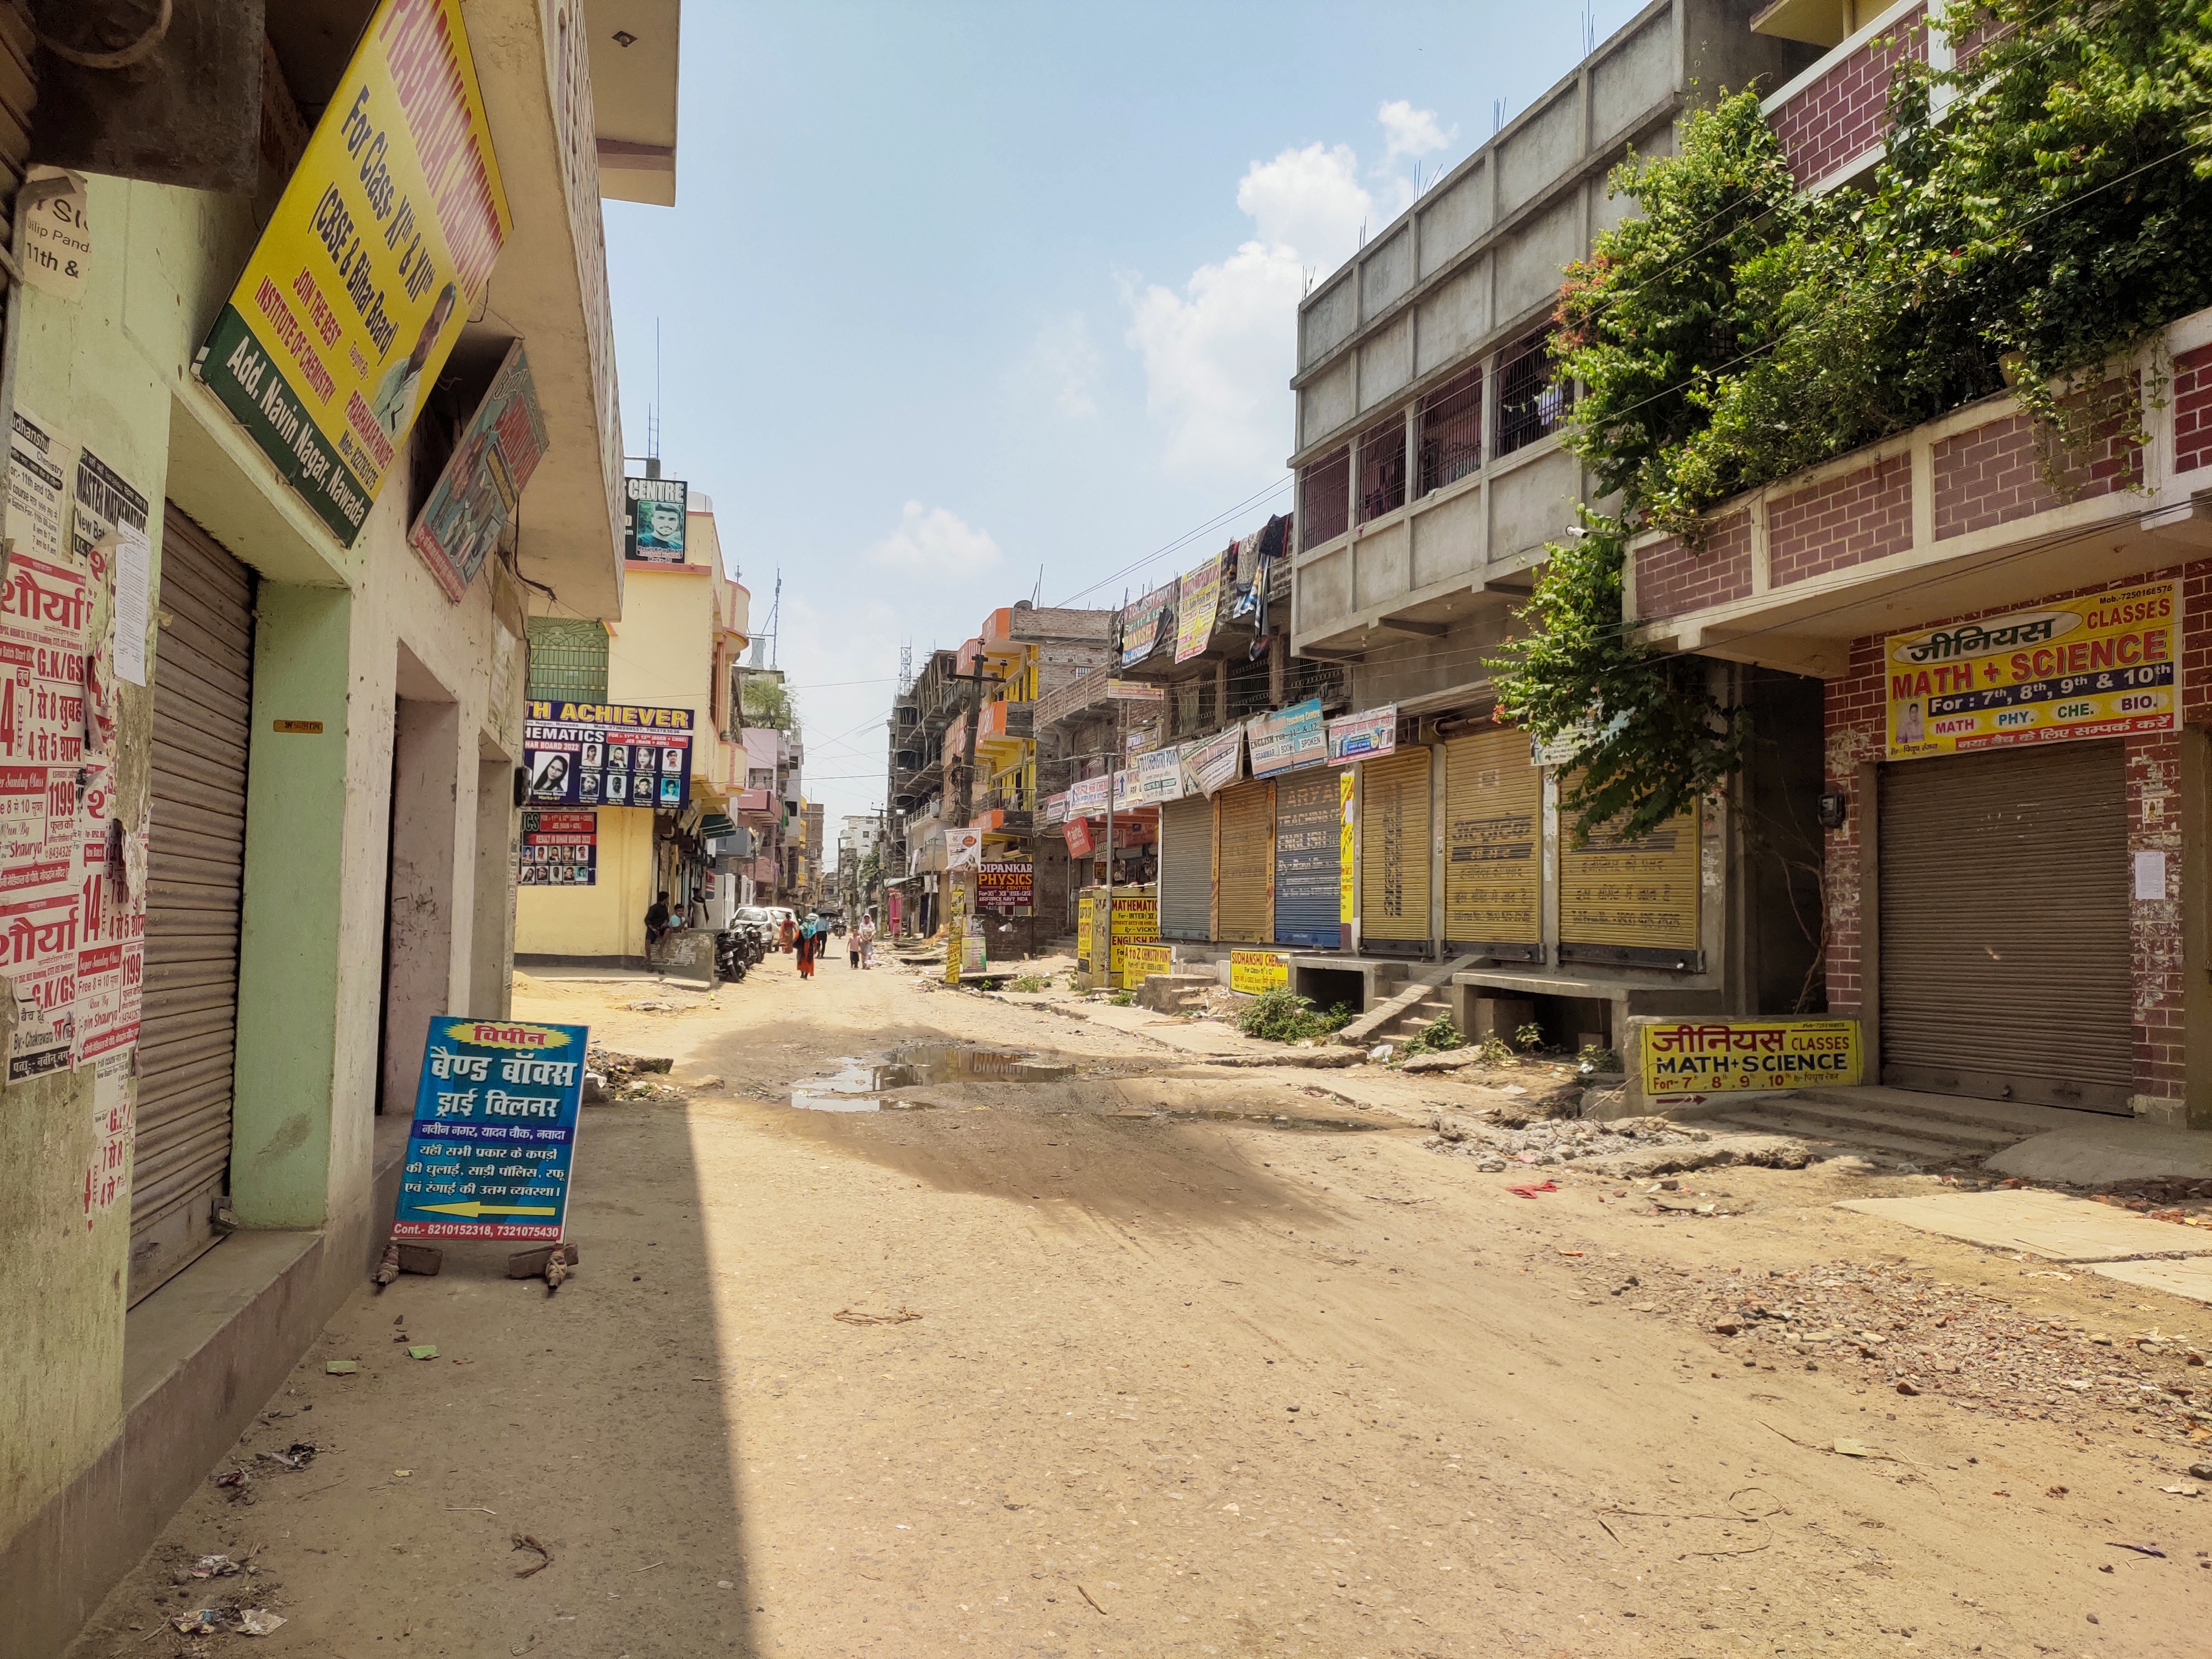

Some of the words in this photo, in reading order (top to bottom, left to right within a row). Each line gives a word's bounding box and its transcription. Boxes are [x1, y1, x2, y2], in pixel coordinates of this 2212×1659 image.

[341, 84, 373, 162] For
[399, 232, 421, 278] &
[307, 181, 355, 265] (CBSE
[436, 133, 504, 305] CHEMISTRY
[27, 242, 59, 271] 11th
[65, 260, 79, 279] &
[338, 236, 361, 279] &
[346, 249, 376, 317] Bihar
[254, 274, 299, 349] INSTITUTE
[293, 265, 317, 308] JOIN
[308, 289, 329, 328] THE
[319, 312, 342, 352] BEST
[289, 330, 308, 360] OF
[364, 289, 400, 367] Board)
[348, 340, 364, 368] Taught
[298, 344, 337, 407] CHEMISTRY
[226, 335, 268, 400] Add.
[259, 376, 300, 445] Navin
[293, 421, 333, 493] Nagar,
[326, 465, 366, 528] Nawada
[344, 388, 382, 455] PRABHAKAR
[373, 431, 395, 473] PANDEY
[34, 482, 44, 495] and
[76, 463, 105, 518] MASTER
[628, 479, 685, 503] CENTRE
[75, 507, 92, 535] New
[1906, 618, 2056, 661] जीनियस
[2086, 598, 2171, 630] CLASSES
[37, 648, 84, 684] G.K/GS
[1892, 662, 1973, 701] MATH
[1983, 661, 2001, 683] +
[2010, 629, 2168, 682] SCIENCE
[1931, 698, 1964, 713] For
[2060, 676, 2088, 695] 9th
[2096, 673, 2115, 690] &
[2124, 665, 2171, 686] 10th
[29, 688, 34, 718] 7
[36, 684, 48, 719] से
[50, 691, 56, 722] 8
[59, 695, 83, 731] सुबह
[560, 703, 689, 728] ACHIEVER
[1936, 718, 1975, 735] MATH
[1999, 711, 2034, 727] PHY.
[2058, 703, 2095, 718] CHE.
[2122, 695, 2157, 711] BIO.
[28, 731, 35, 761] 4
[38, 727, 49, 761] से
[50, 733, 56, 761] 5
[60, 736, 82, 762] शाम
[1250, 735, 1274, 750] ENGLISH
[1301, 736, 1321, 748] SPOKEN
[1958, 738, 1988, 748] नया
[2018, 730, 2037, 742] के
[2040, 728, 2071, 740] लिए
[2074, 719, 2132, 737] सम्पर्क
[2136, 714, 2171, 729] करें
[21, 799, 30, 814] 10
[49, 781, 75, 817] 1199
[9, 840, 43, 859] Shaurya
[978, 863, 1033, 873] DIPANKAR
[978, 874, 1033, 885] PHYSICS
[83, 874, 102, 943] 14
[122, 952, 142, 987] 1199
[1232, 952, 1264, 967] SUDHANSHU
[78, 980, 92, 994] Free
[473, 1025, 547, 1046] विपीन
[1652, 1024, 1787, 1053] जीनियस
[1791, 1037, 1850, 1051] CLASSES
[430, 1046, 493, 1082] बैण्ड
[501, 1052, 578, 1087] बॉक्स
[435, 1088, 478, 1118] ड्राई
[485, 1089, 560, 1118] क्लिनर
[422, 1124, 450, 1136] नवीन
[451, 1125, 478, 1138] नगर,
[481, 1127, 507, 1138] यादव
[509, 1126, 534, 1141] चौक,
[536, 1128, 565, 1140] नवादा
[419, 1142, 444, 1156] यहाँ
[446, 1145, 472, 1157] सभी
[475, 1147, 507, 1159] प्रकार
[510, 1146, 523, 1159] के
[404, 1180, 422, 1193] एवं
[425, 1181, 457, 1196] रंगाई
[460, 1183, 477, 1195] की
[479, 1184, 507, 1196] उत्तम
[405, 1162, 422, 1174] की
[426, 1162, 464, 1178] धुलाई,
[468, 1164, 495, 1179] साड़ी
[545, 1169, 565, 1182] रफू
[393, 1223, 425, 1235] Cont.-
[427, 1224, 494, 1238] 8210152318,
[497, 1225, 559, 1238] 7321075430
